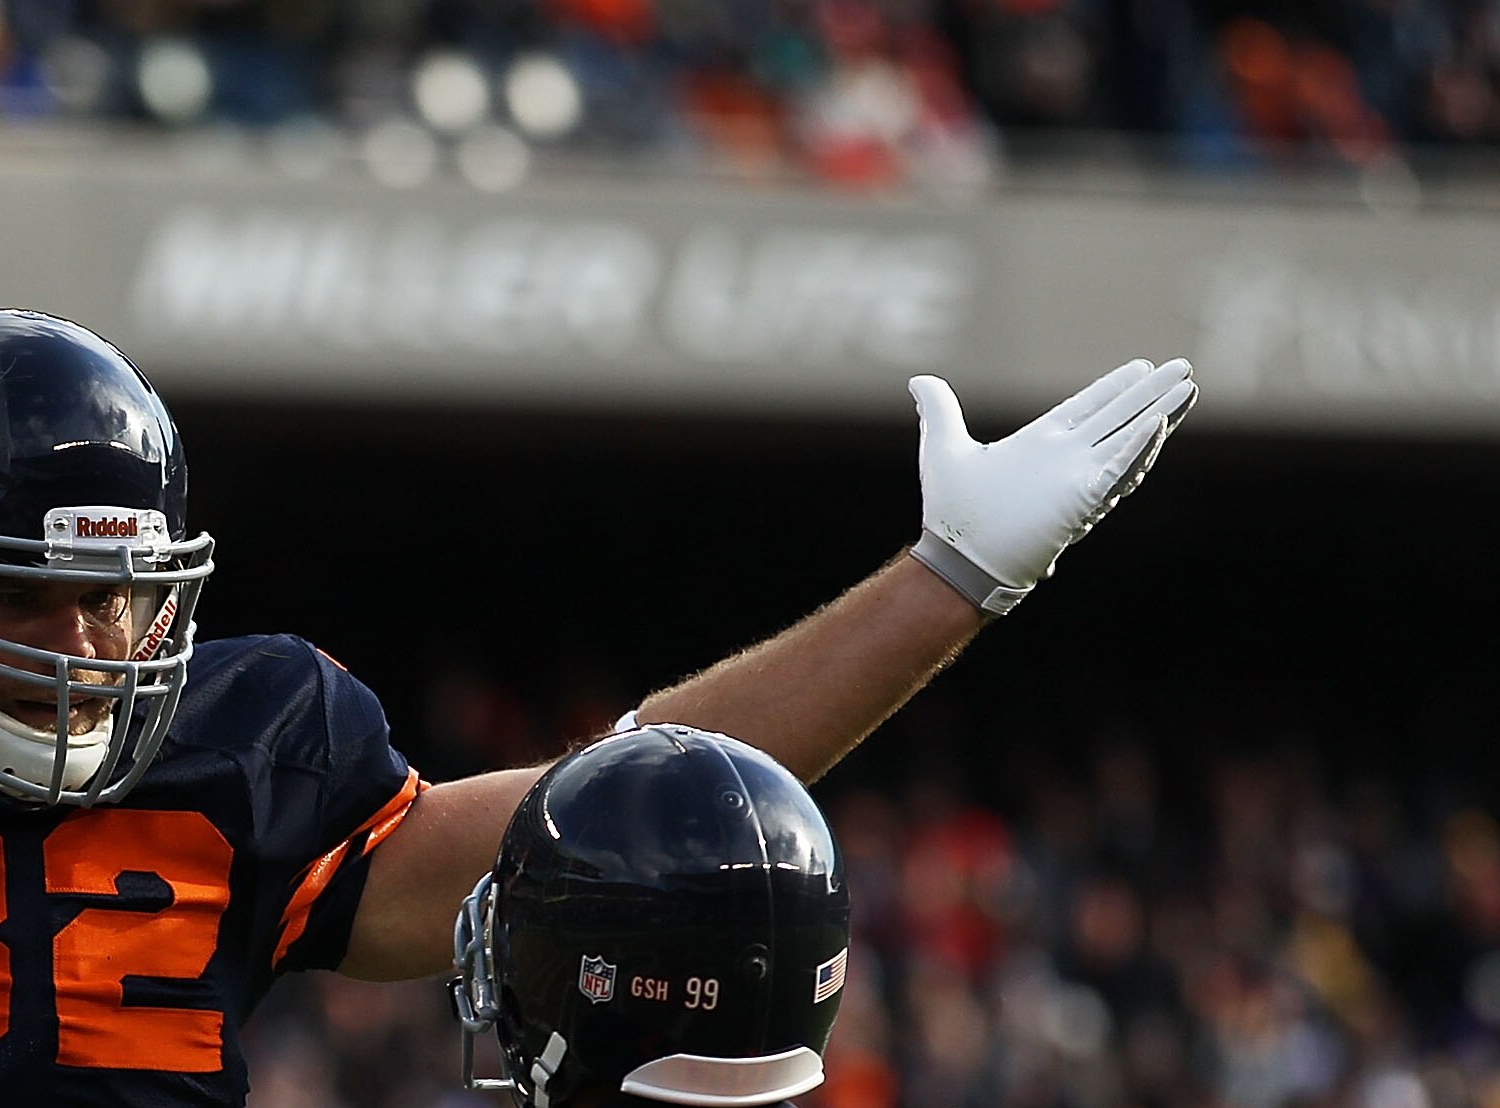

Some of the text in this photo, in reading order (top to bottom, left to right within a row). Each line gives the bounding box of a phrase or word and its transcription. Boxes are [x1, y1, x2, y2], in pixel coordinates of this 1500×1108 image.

[76, 516, 138, 537] Riddell
[583, 973, 611, 998] NFL
[631, 976, 719, 1010] GSH 99
